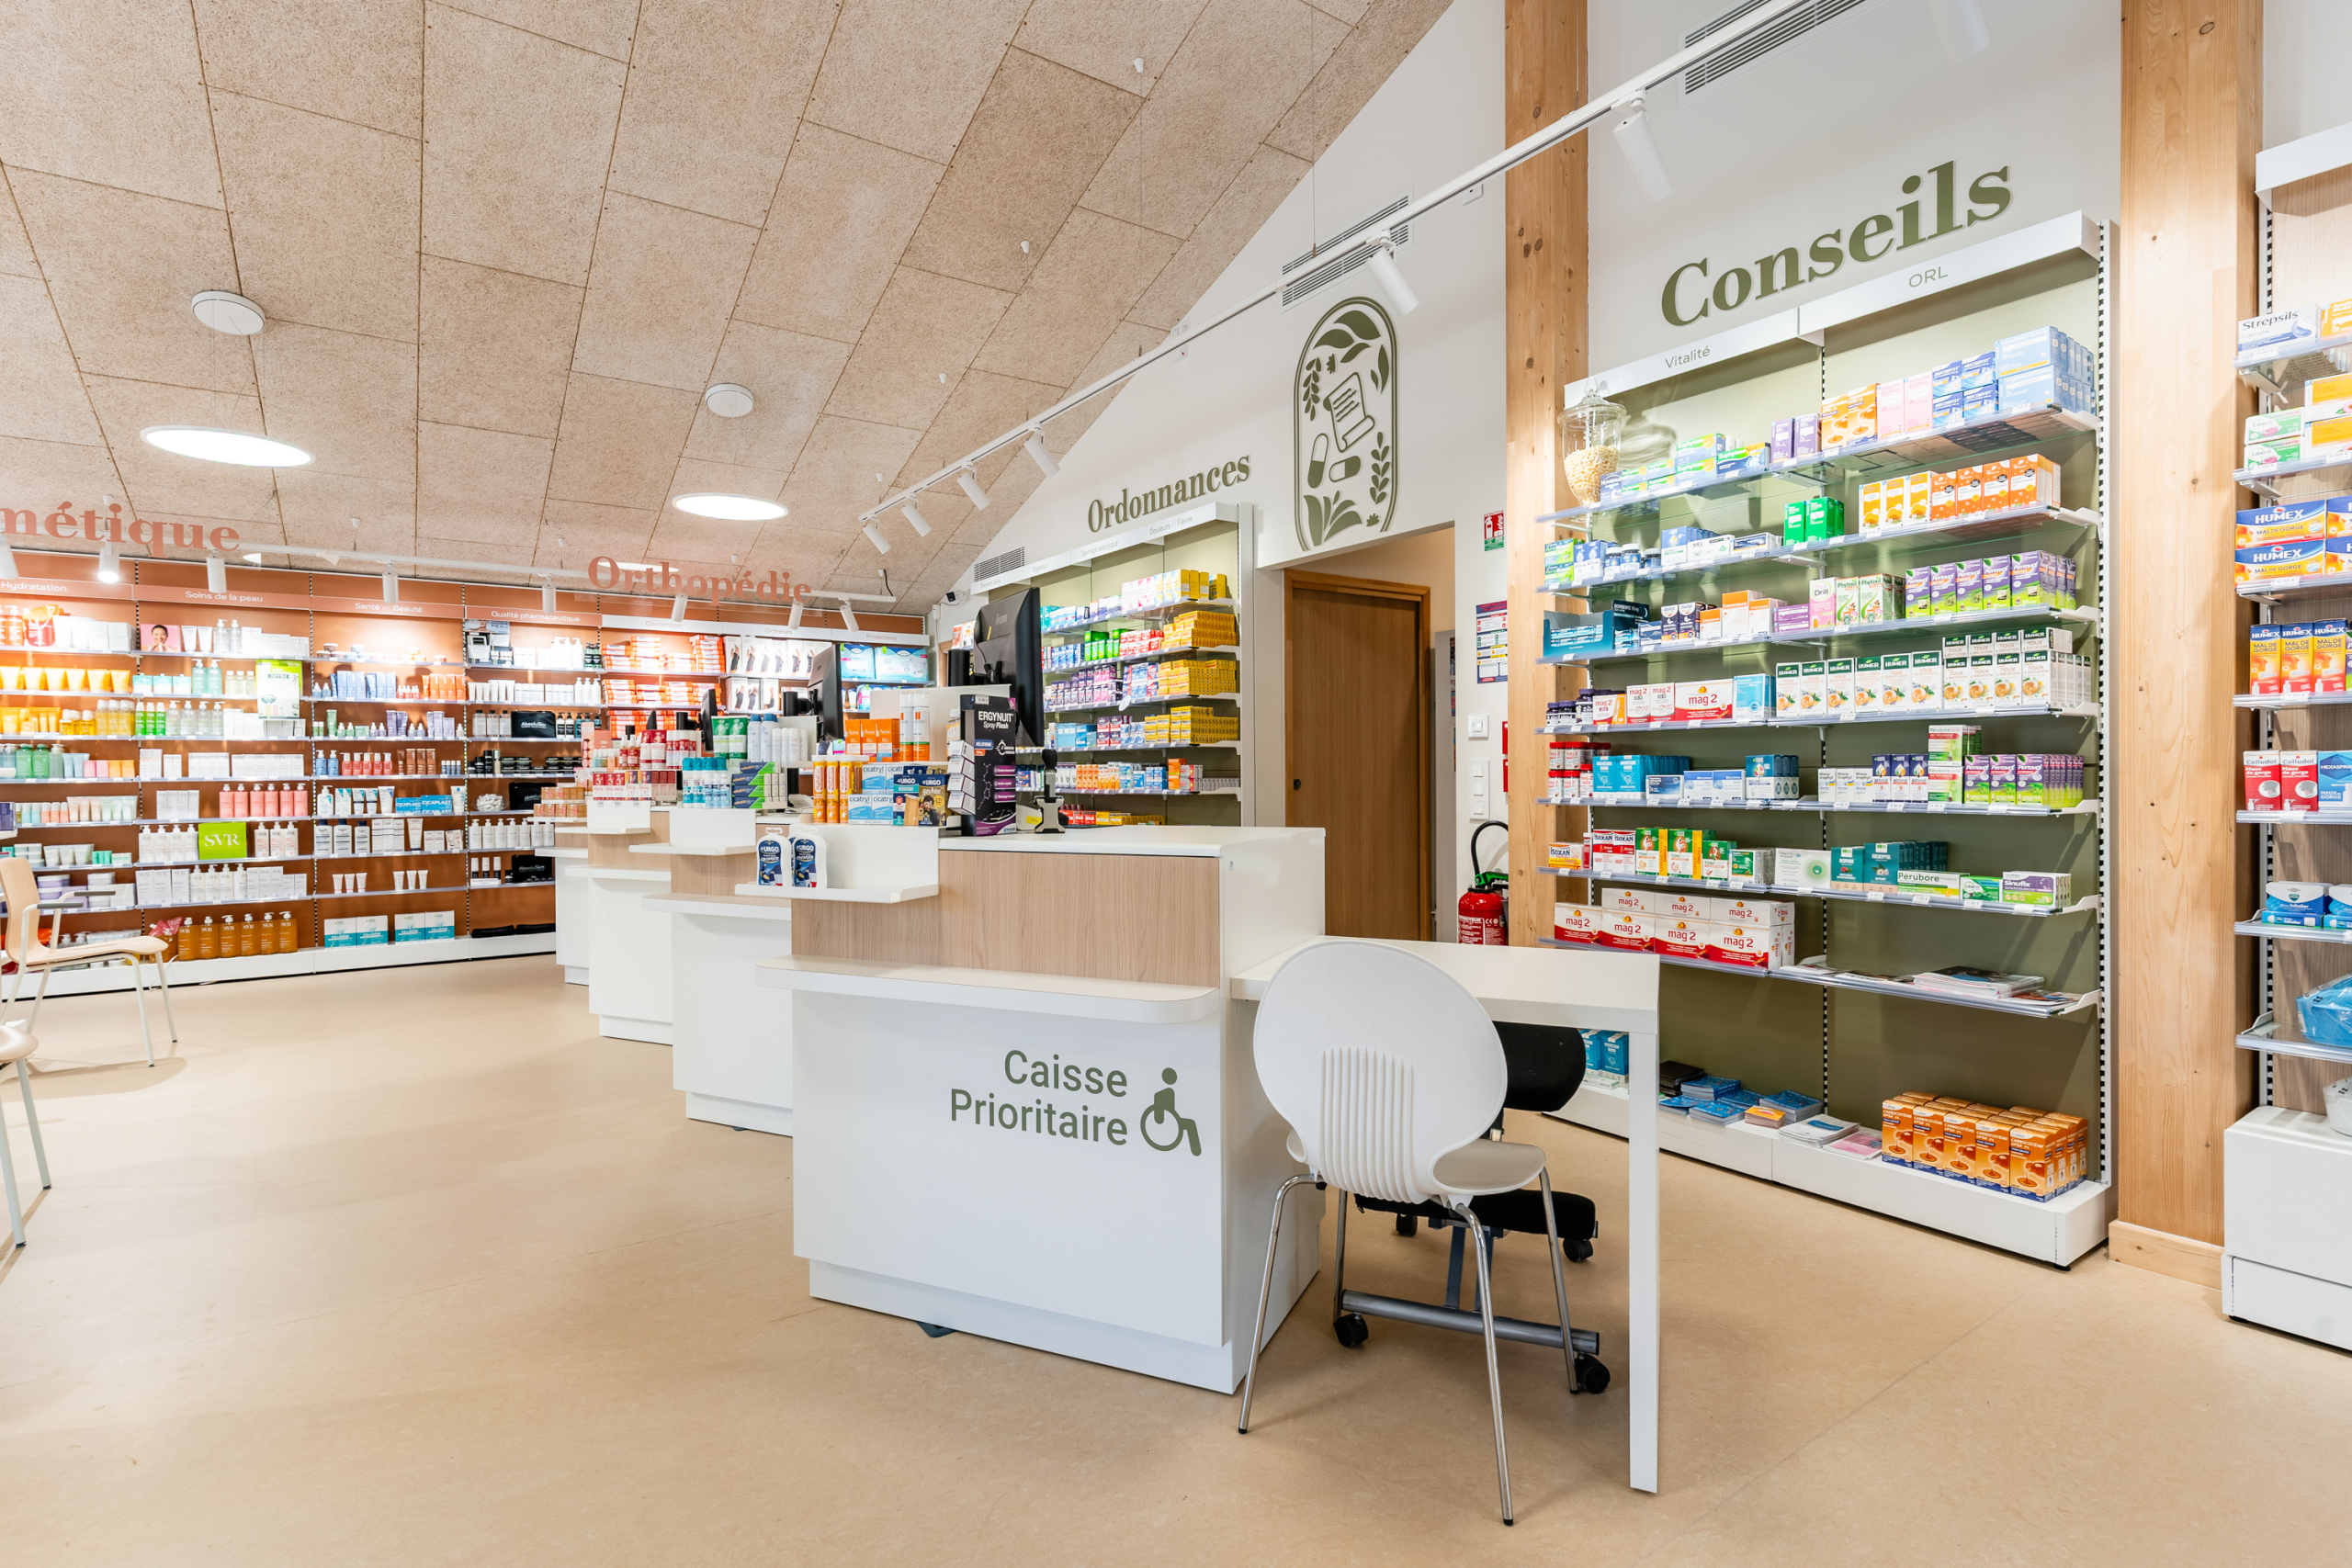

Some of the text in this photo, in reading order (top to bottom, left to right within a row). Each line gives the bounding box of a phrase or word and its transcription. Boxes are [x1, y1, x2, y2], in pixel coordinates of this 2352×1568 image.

[1661, 160, 2011, 327] Conseils
[1907, 265, 1949, 288] ORL
[2242, 310, 2299, 331] Strepsils
[1665, 344, 1711, 369] Vitalité
[1964, 357, 1991, 368] MUCOMYST
[1933, 367, 1961, 377] MUCOMYST
[1966, 389, 1992, 400] MUCOMYST
[1935, 398, 1961, 409] MUCOMYST
[1088, 454, 1251, 534] Ordonnances
[2255, 509, 2305, 525] HUMEX
[0, 502, 241, 558] métique
[1149, 523, 1170, 536] Douleurs
[1177, 514, 1193, 525] Fièvre
[2279, 525, 2304, 533] GORGE
[1081, 540, 1118, 557] Sevrage tabagique
[2253, 548, 2302, 563] HUMEX
[1032, 563, 1048, 573] Digestion
[588, 556, 812, 606] Orthopédie
[1838, 580, 1858, 589] Phytoxil
[1861, 577, 1882, 586] Phytoxil
[0, 581, 68, 593] Hydratation
[1814, 588, 1829, 596] Drill
[185, 591, 263, 604] Soins de la peau
[355, 602, 380, 611] Santé
[392, 604, 424, 614] Beauté
[491, 610, 581, 623] Qualité pharmaceutique
[645, 620, 683, 628] Contention
[2251, 630, 2280, 639] HUMEX
[2282, 628, 2312, 637] HUMEX
[2314, 626, 2345, 636] HUMEX
[1915, 657, 1938, 665] HUMER
[1689, 694, 1717, 705] mag 2
[978, 710, 1013, 722] ERGYNUIT
[983, 721, 996, 730] Spray
[862, 765, 884, 773] cicatryl
[849, 795, 870, 805] cicatryl
[204, 833, 241, 847] SVR
[1550, 847, 1570, 856] ISOXAN
[1898, 872, 1939, 883] Perubore
[2004, 880, 2031, 888] Sinufix
[1728, 908, 1753, 919] mag 2
[1566, 917, 1590, 928] mag 2
[1614, 923, 1642, 935] mag 2
[1668, 930, 1696, 942] mag 2
[1724, 935, 1754, 948] mag 2
[1004, 1049, 1128, 1098] Caisse
[951, 1088, 1128, 1146] Prioritaire
[1883, 1109, 1912, 1119] CARBOCISTÉINE
[1913, 1115, 1943, 1126] CARBOCISTÉINE
[1944, 1122, 1974, 1134] CARBOCISTÉINE
[1976, 1130, 2008, 1142] CARBOCISTÉINE
[2010, 1137, 2044, 1148] CARBOCISTÉINE
